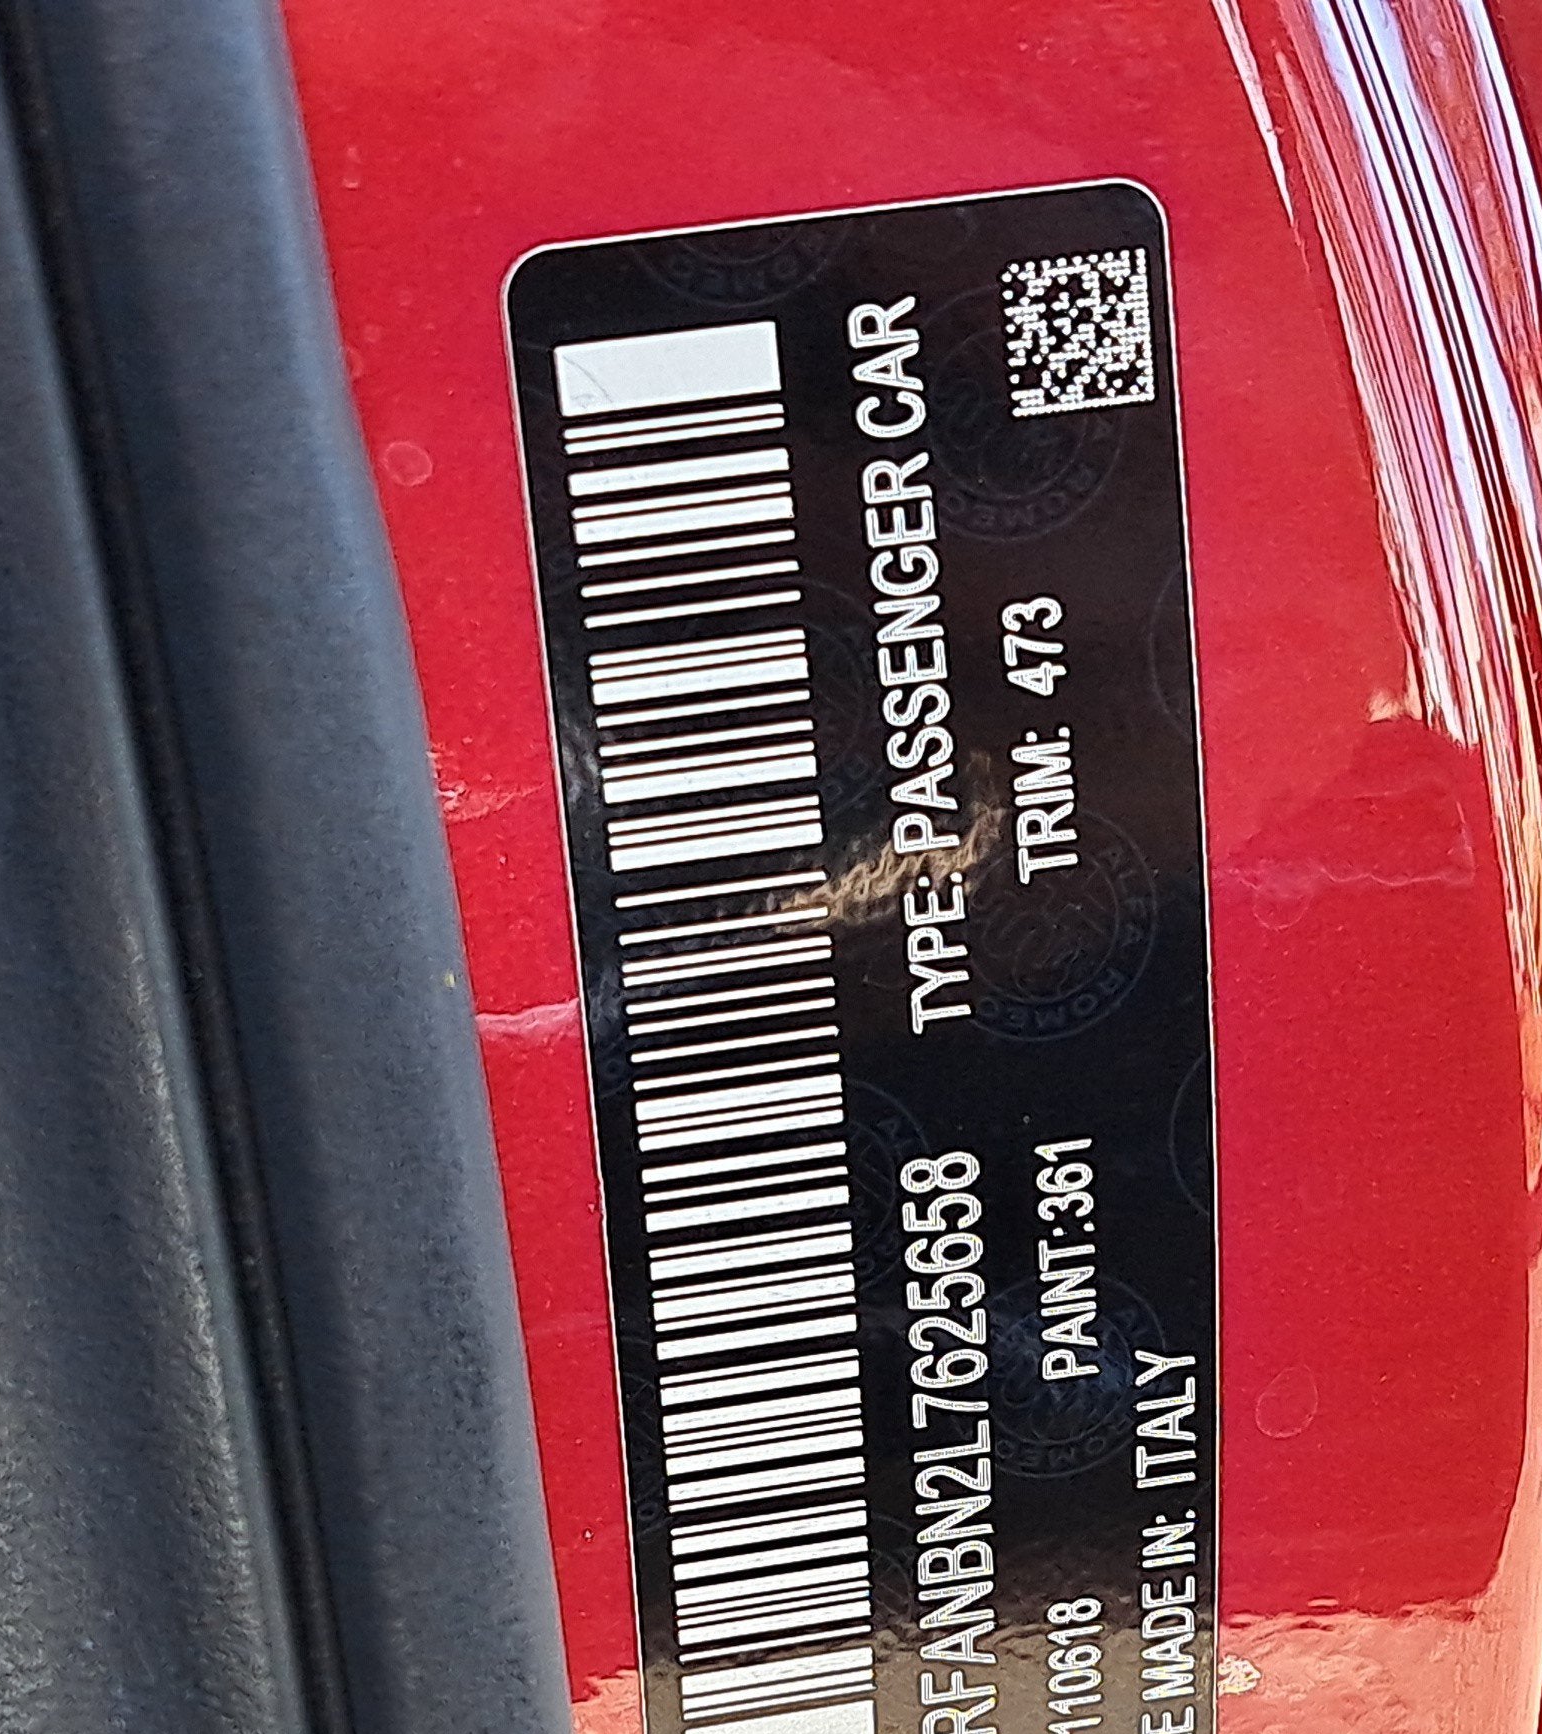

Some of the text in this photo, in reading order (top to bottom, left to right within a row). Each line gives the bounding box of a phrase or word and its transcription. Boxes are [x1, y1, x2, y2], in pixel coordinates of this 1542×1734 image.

[847, 297, 971, 1034] TYPE: PASSENGER CAR
[1001, 596, 1078, 884] TRIM: 473
[1134, 1348, 1197, 1489] ITALY
[1140, 1509, 1197, 1568] IN:
[1140, 1577, 1197, 1701] MADE
